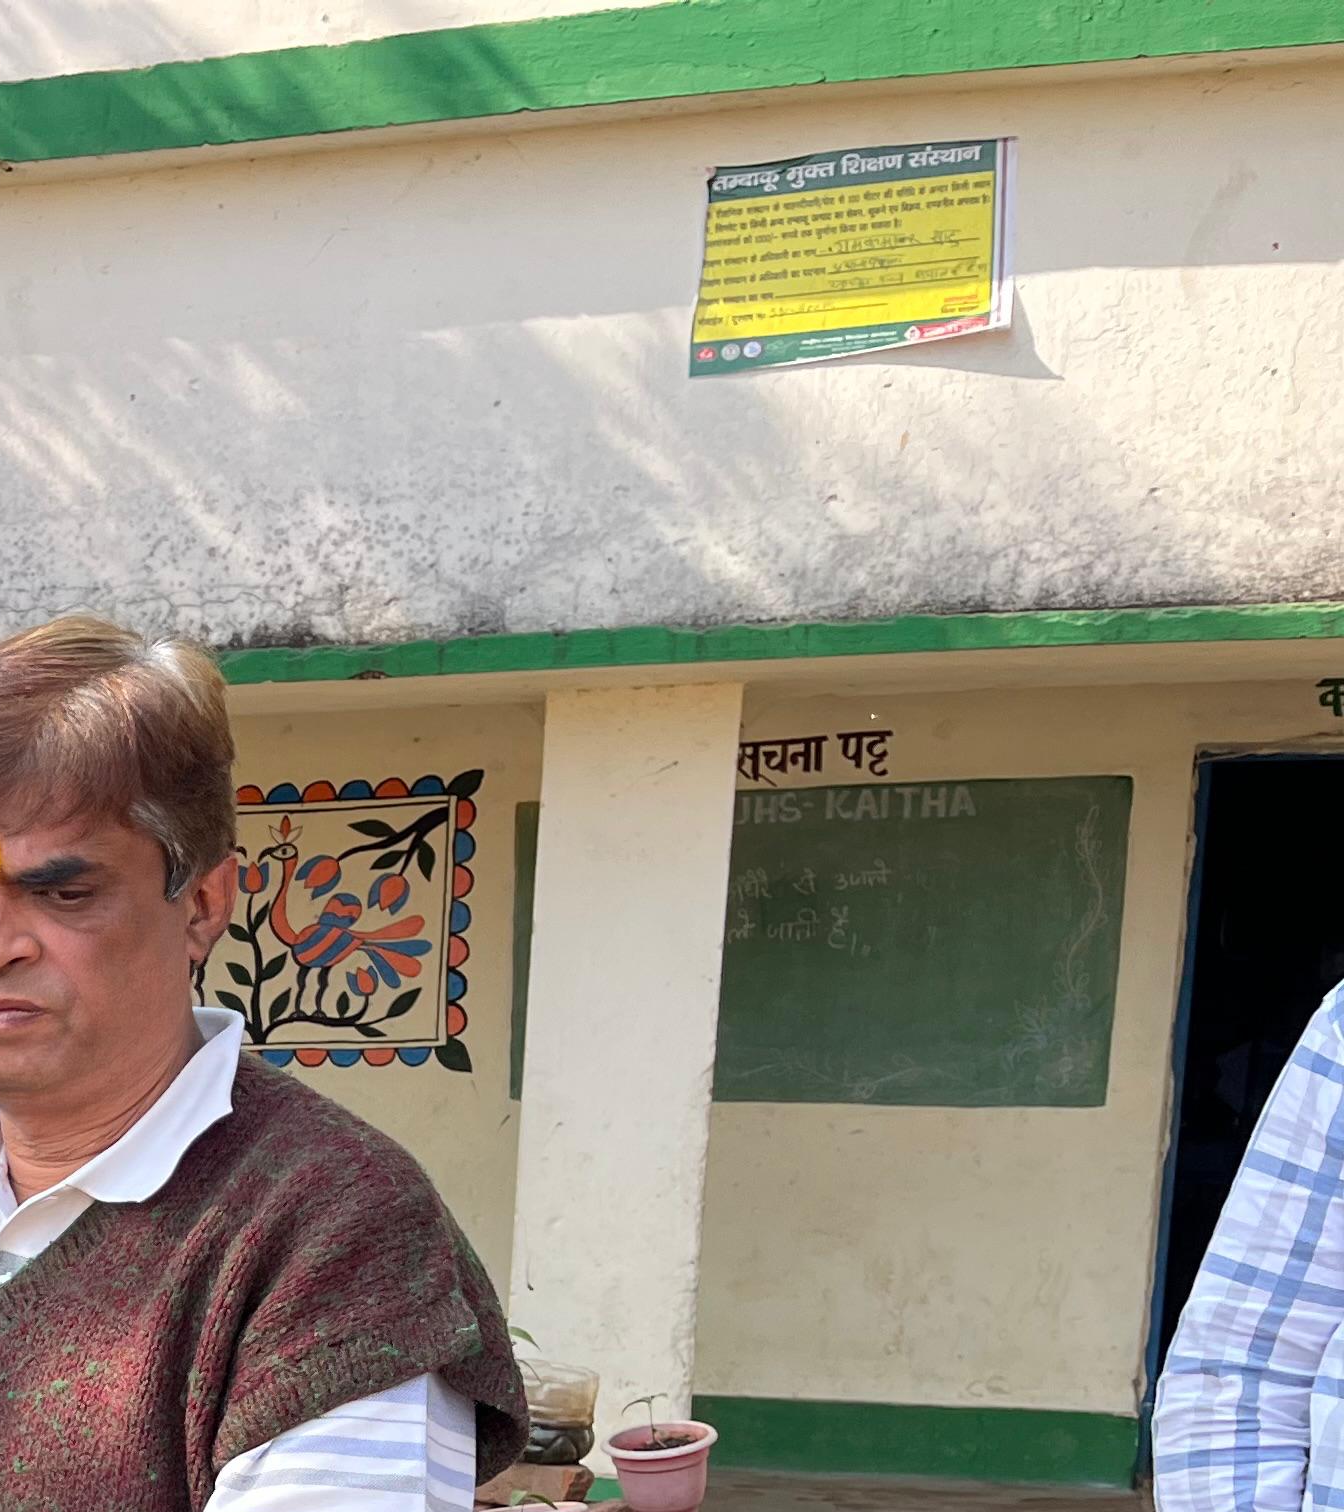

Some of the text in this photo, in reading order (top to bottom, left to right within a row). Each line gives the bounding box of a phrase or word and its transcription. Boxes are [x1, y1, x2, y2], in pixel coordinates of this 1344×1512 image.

[785, 160, 835, 188] मुक्त
[841, 153, 904, 175] शिक्षण
[908, 145, 983, 168] संस्थान
[737, 735, 828, 787] सूचना
[824, 785, 977, 821] KAITHA
